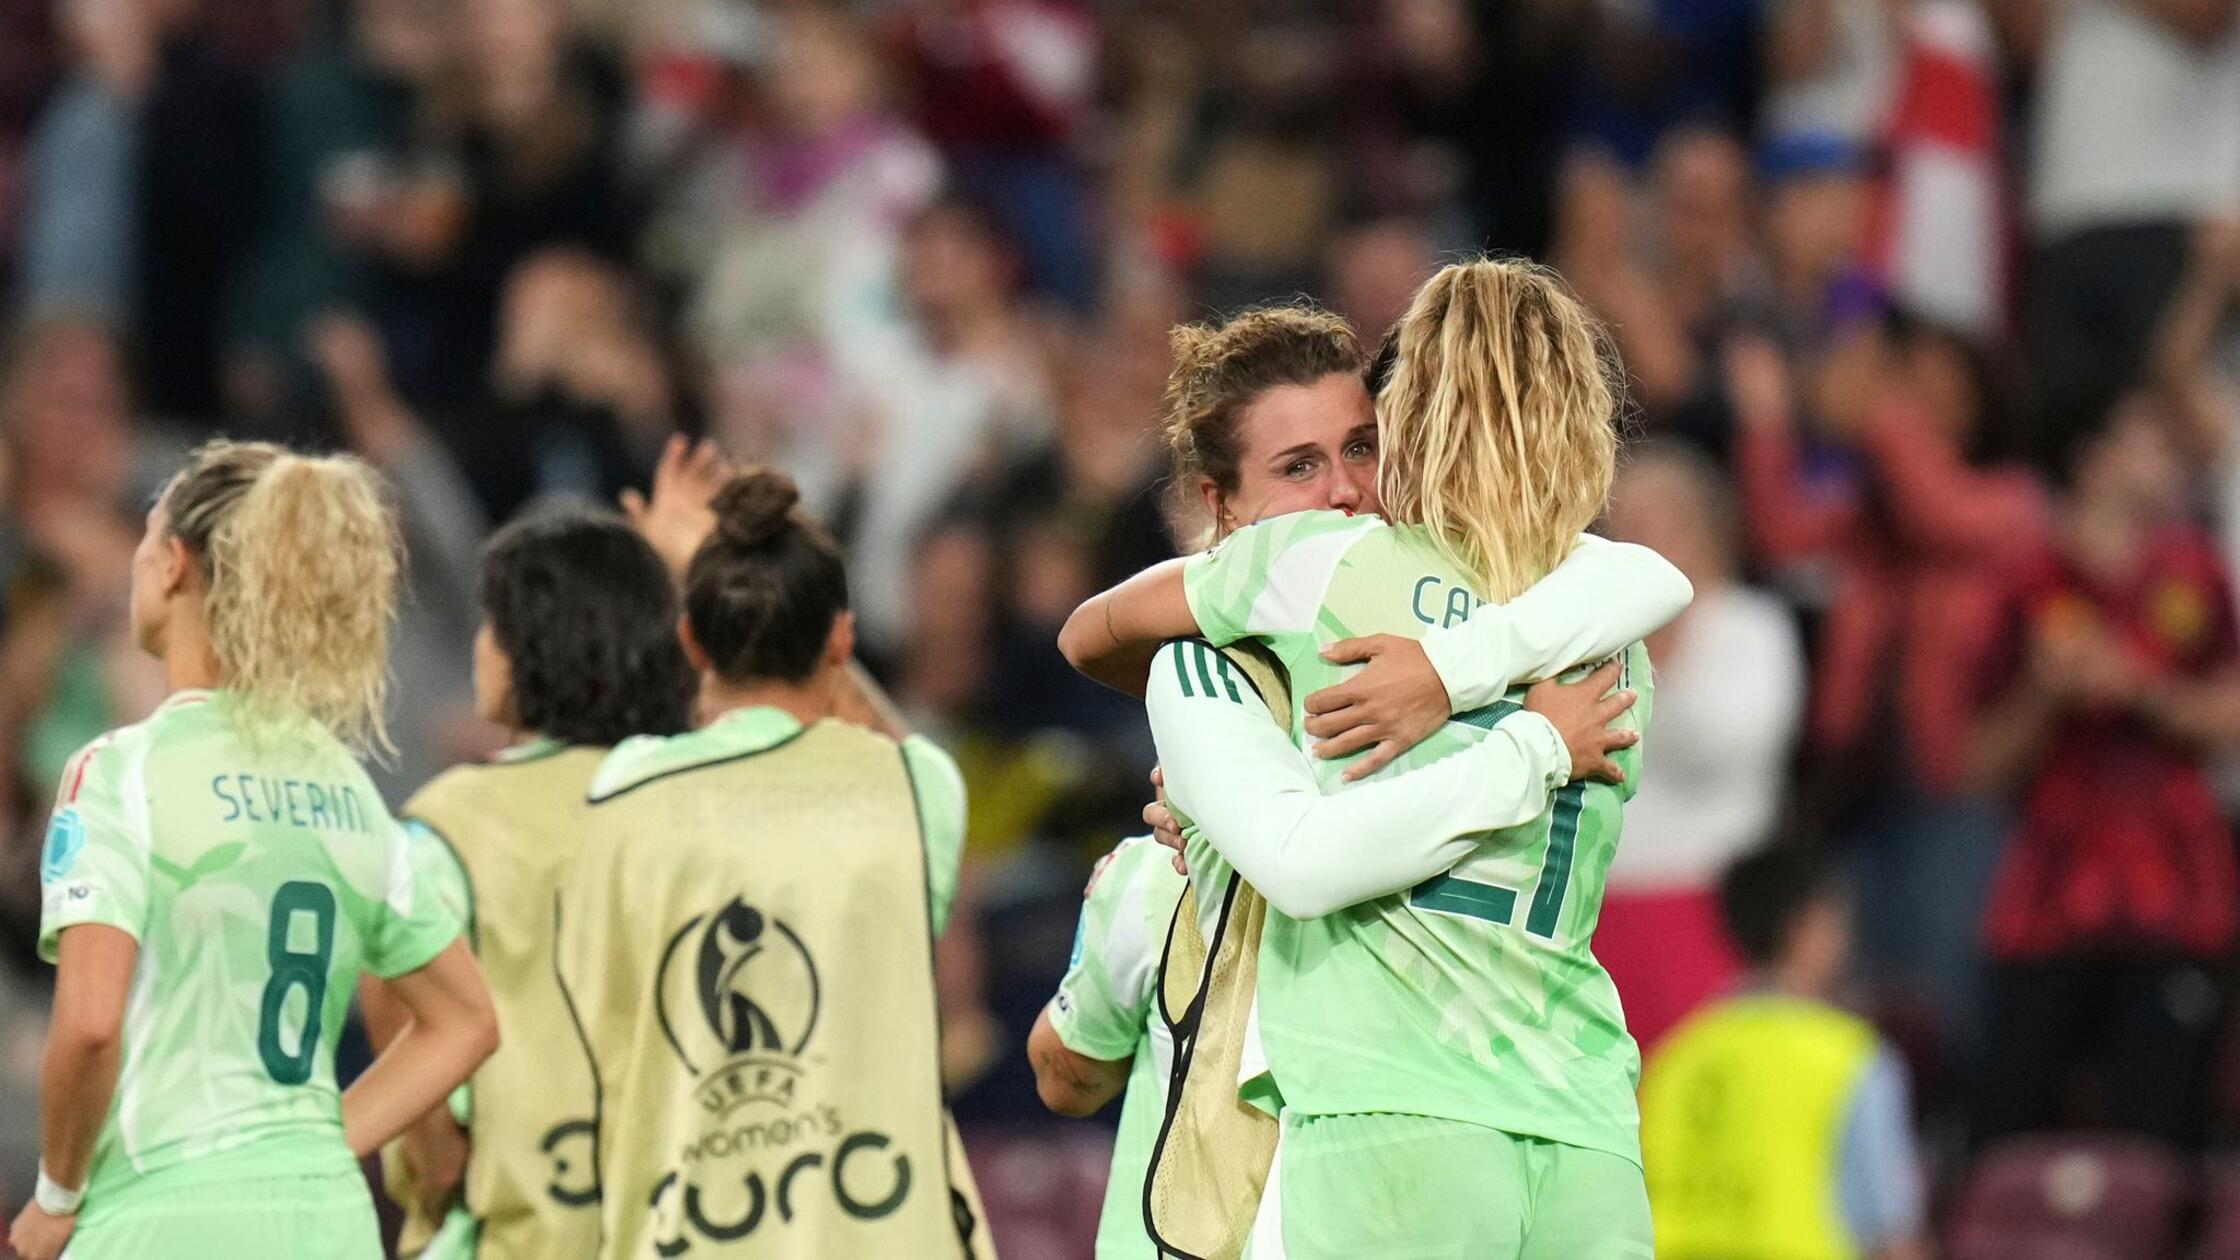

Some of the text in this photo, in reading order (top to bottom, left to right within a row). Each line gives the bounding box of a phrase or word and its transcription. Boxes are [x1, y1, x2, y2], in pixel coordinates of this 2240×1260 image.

[212, 774, 373, 836] SEVERIN
[258, 880, 336, 1085] 8
[703, 1068, 796, 1113] UEFA
